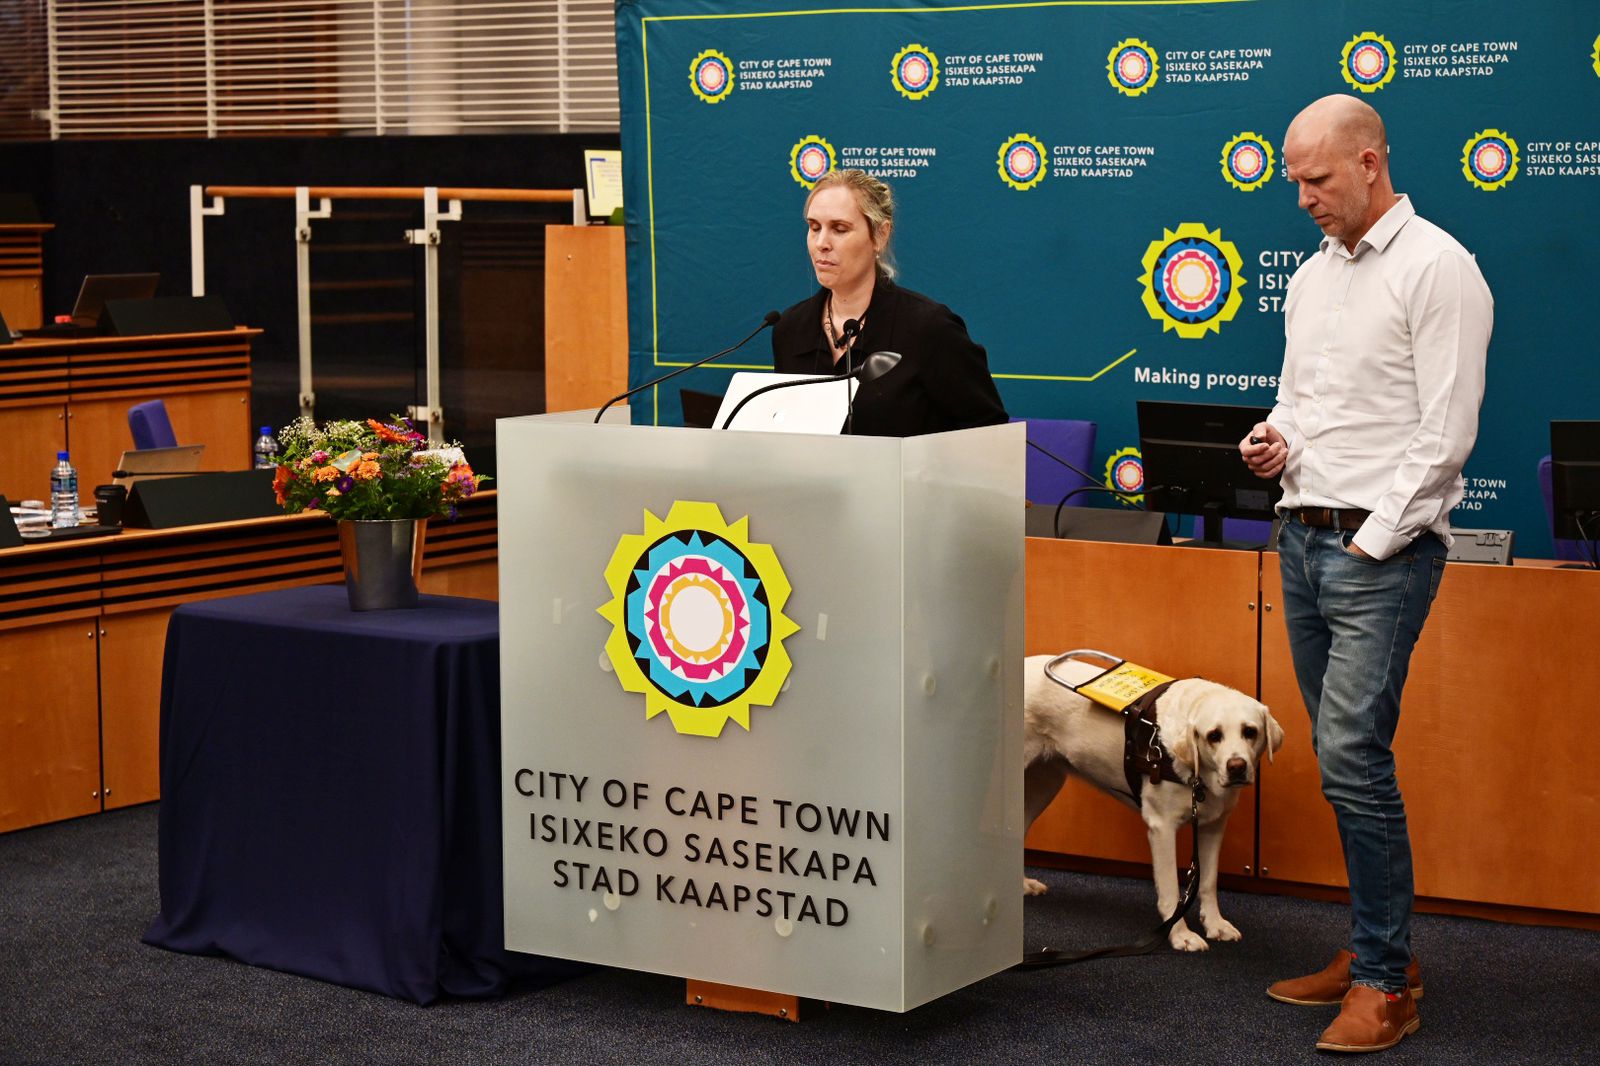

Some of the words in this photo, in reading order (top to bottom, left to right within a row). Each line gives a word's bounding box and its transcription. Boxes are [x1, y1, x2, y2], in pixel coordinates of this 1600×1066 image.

[1403, 44, 1428, 55] CITY
[1431, 44, 1447, 54] OF
[1450, 42, 1480, 53] CAPE
[1483, 41, 1518, 52] TOWN
[944, 55, 967, 65] CITY
[968, 54, 983, 65] OF
[984, 53, 1011, 64] CAPE
[1013, 52, 1043, 63] TOWN
[1165, 51, 1188, 61] CITY
[1190, 50, 1206, 60] OF
[1208, 49, 1236, 60] CAPE
[1238, 48, 1272, 58] TOWN
[1403, 55, 1448, 66] ISIXEKO
[1451, 54, 1509, 65] SASEKAPA
[739, 60, 760, 70] CITY
[761, 59, 775, 69] OF
[777, 58, 801, 68] CAPE
[803, 58, 832, 67] TOWN
[945, 66, 984, 76] ISIXEKO
[986, 64, 1036, 75] SASEKAPA
[1165, 61, 1207, 72] ISIXEKO
[1209, 60, 1264, 71] SASEKAPA
[739, 70, 776, 80] ISIXEKO
[778, 68, 825, 79] SASEKAPA
[1165, 73, 1192, 83] STAD
[1194, 72, 1249, 82] KAAPSTAD
[1403, 68, 1432, 78] STAD
[1435, 66, 1494, 77] KAAPSTAD
[740, 81, 764, 91] STAD
[765, 79, 813, 90] KAAPSTAD
[945, 77, 970, 87] STAD
[972, 75, 1023, 86] KAAPSTAD
[841, 147, 863, 156] CITY
[864, 147, 878, 156] OF
[880, 147, 905, 157] CAPE
[906, 147, 936, 157] TOWN
[1053, 145, 1076, 155] CITY
[1077, 145, 1092, 155] OF
[1094, 146, 1121, 155] CAPE
[1123, 146, 1155, 156] TOWN
[1527, 142, 1552, 152] CITY
[1555, 142, 1571, 152] OF
[1574, 141, 1600, 152] CAP
[842, 158, 879, 167] ISIXEKO
[881, 158, 929, 167] SASEKAPA
[1053, 157, 1093, 166] ISIXEKO
[1095, 157, 1147, 167] SASEKAPA
[1527, 154, 1572, 164] ISIXEKO
[1053, 168, 1079, 177] STAD
[1081, 168, 1133, 178] KAAPSTAD
[1526, 166, 1555, 176] STAD
[1258, 250, 1305, 267] CITY
[1134, 366, 1201, 389] Making
[1472, 478, 1506, 489] TOWN
[514, 768, 589, 803] CITY
[602, 779, 649, 810] OF
[665, 786, 758, 826] CAPE
[772, 799, 890, 842] TOWN
[530, 813, 668, 858] ISIXEKO
[684, 833, 877, 887] SASEKAPA
[553, 859, 639, 897] STAD
[656, 874, 849, 927] KAAPSTAD
